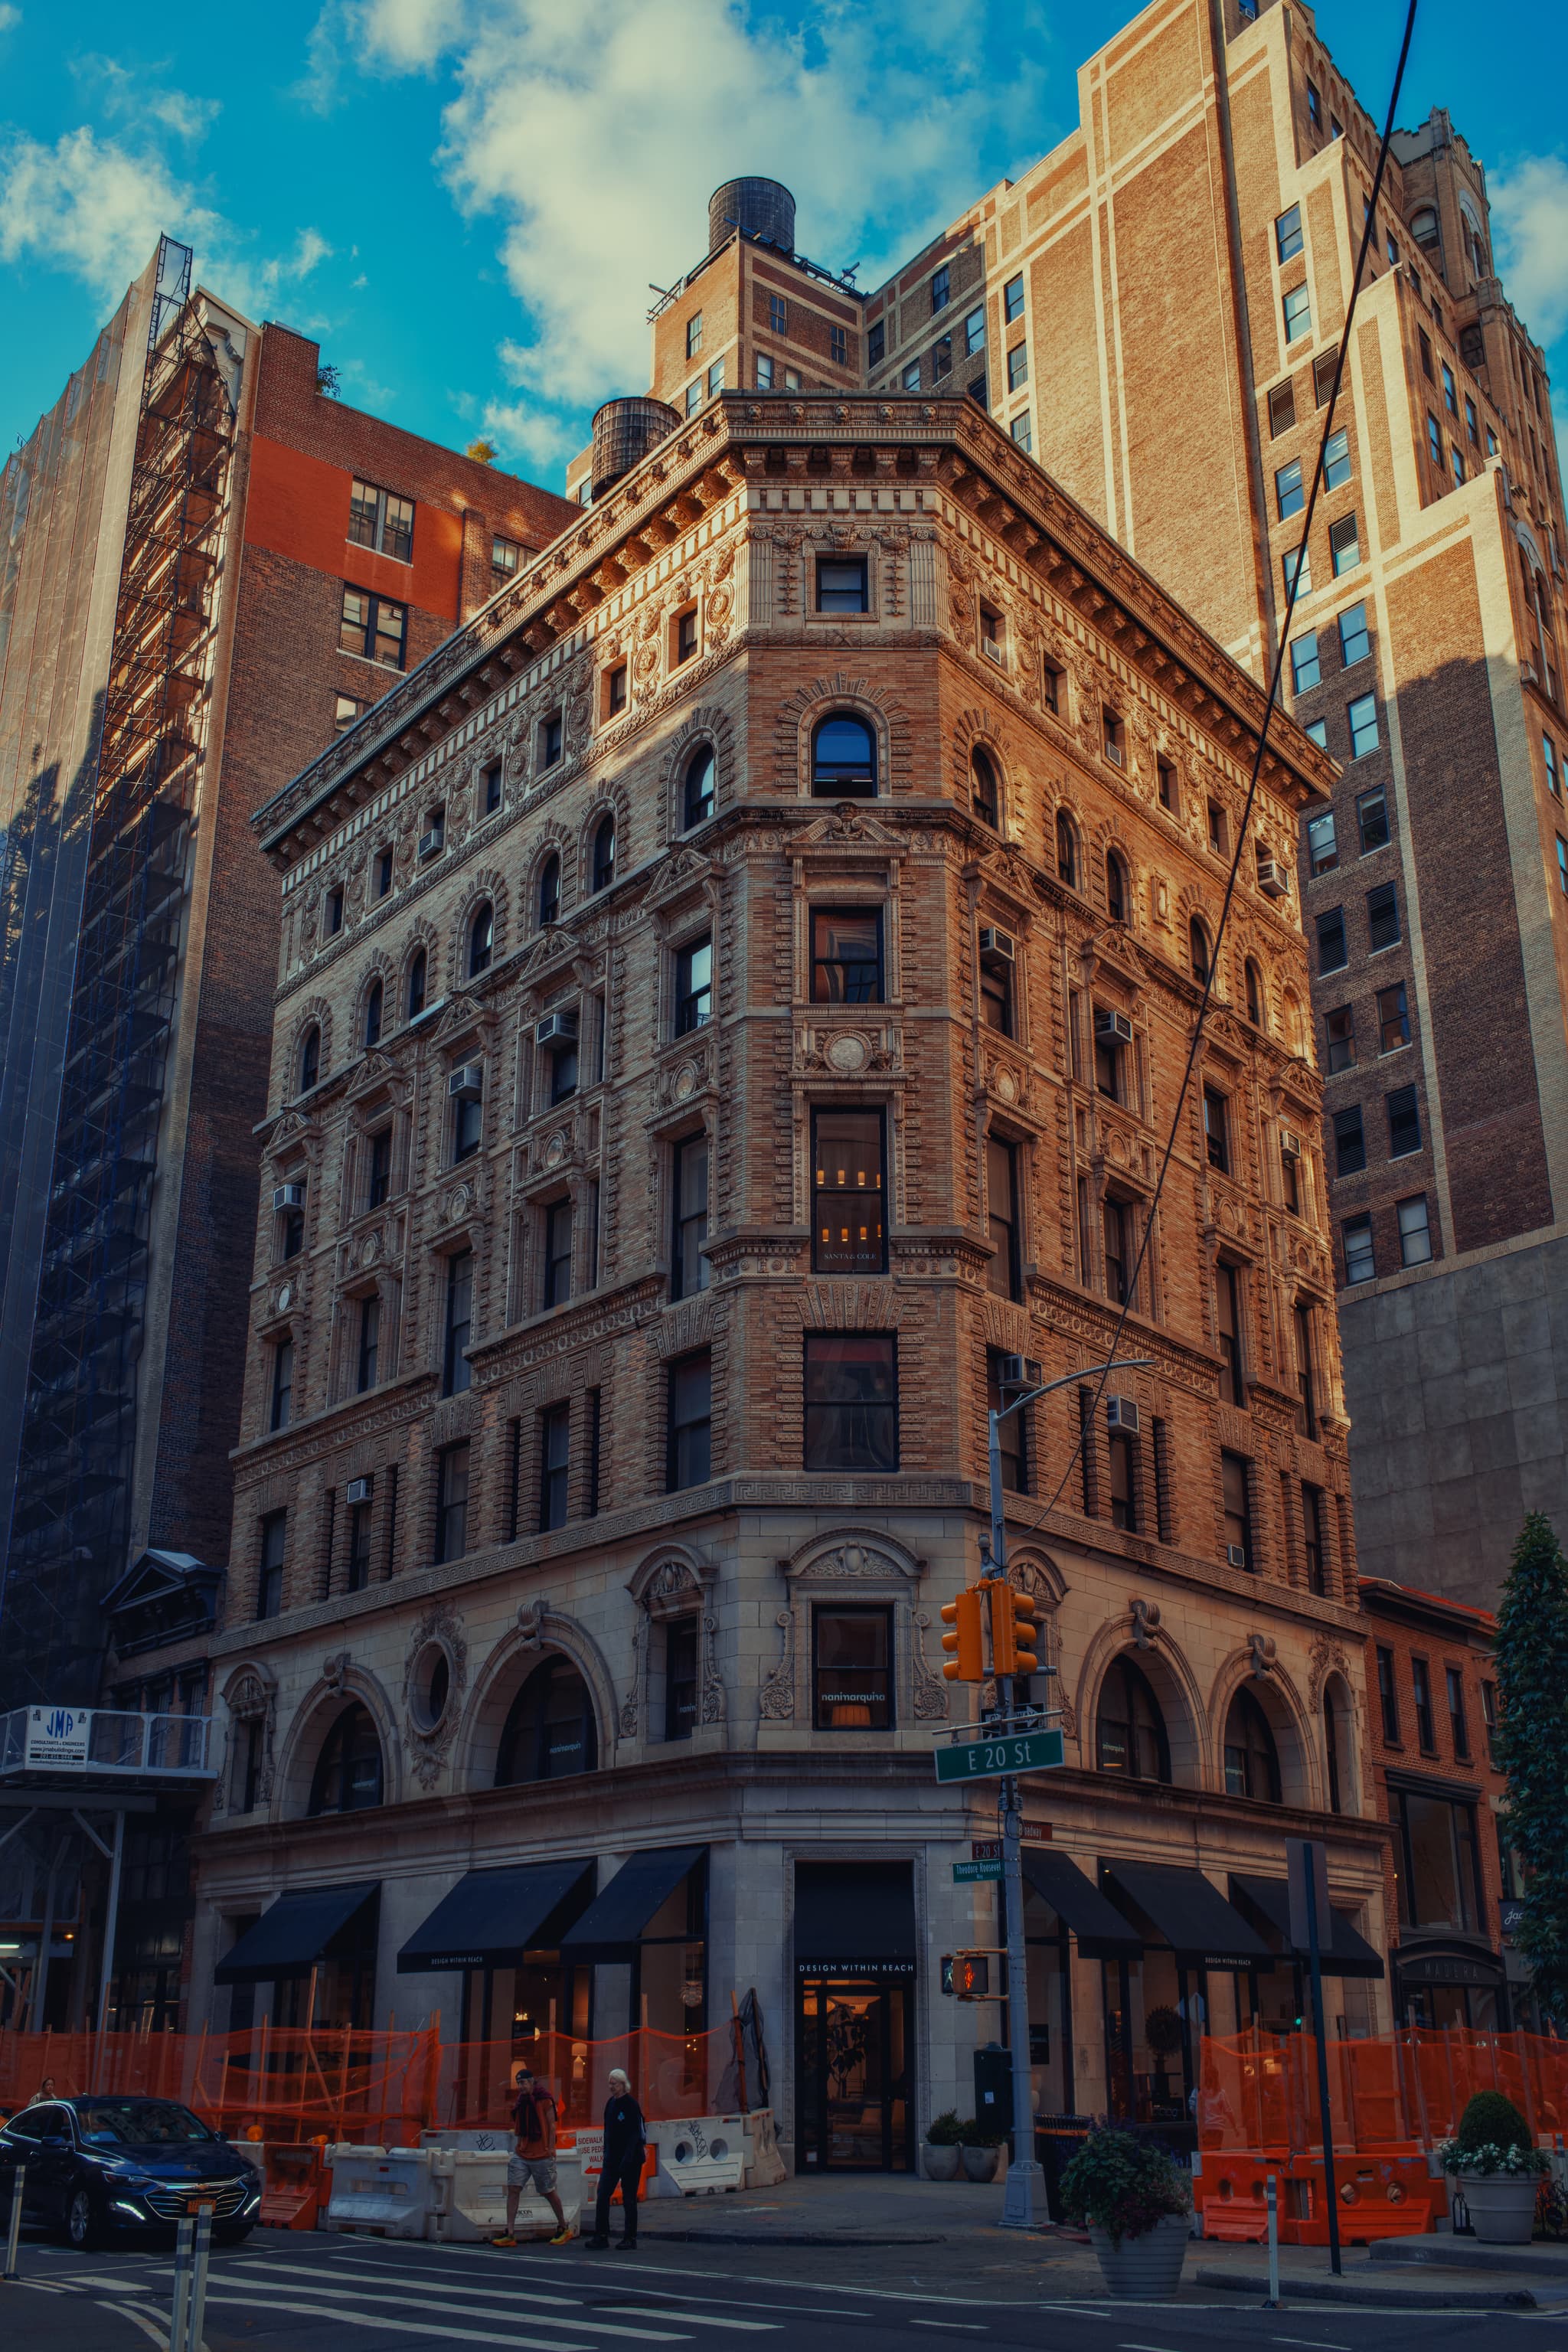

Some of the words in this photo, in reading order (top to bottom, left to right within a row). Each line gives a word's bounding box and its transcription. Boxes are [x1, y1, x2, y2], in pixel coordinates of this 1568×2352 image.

[822, 1691, 885, 1704] nanimarquina
[47, 1710, 74, 1739] JMA
[968, 1750, 978, 1771] E
[985, 1746, 1006, 1769] 20
[1014, 1740, 1032, 1765] St
[1018, 1824, 1042, 1840] Boadway
[975, 1846, 980, 1857] E
[982, 1845, 991, 1858] 20
[956, 1864, 978, 1875] Theodore
[979, 1861, 1001, 1873] Roosevel
[799, 1964, 837, 1972] DESIGN
[841, 1964, 878, 1972] WITHIN
[882, 1964, 913, 1972] REACH
[1424, 1962, 1478, 1979] MADERA
